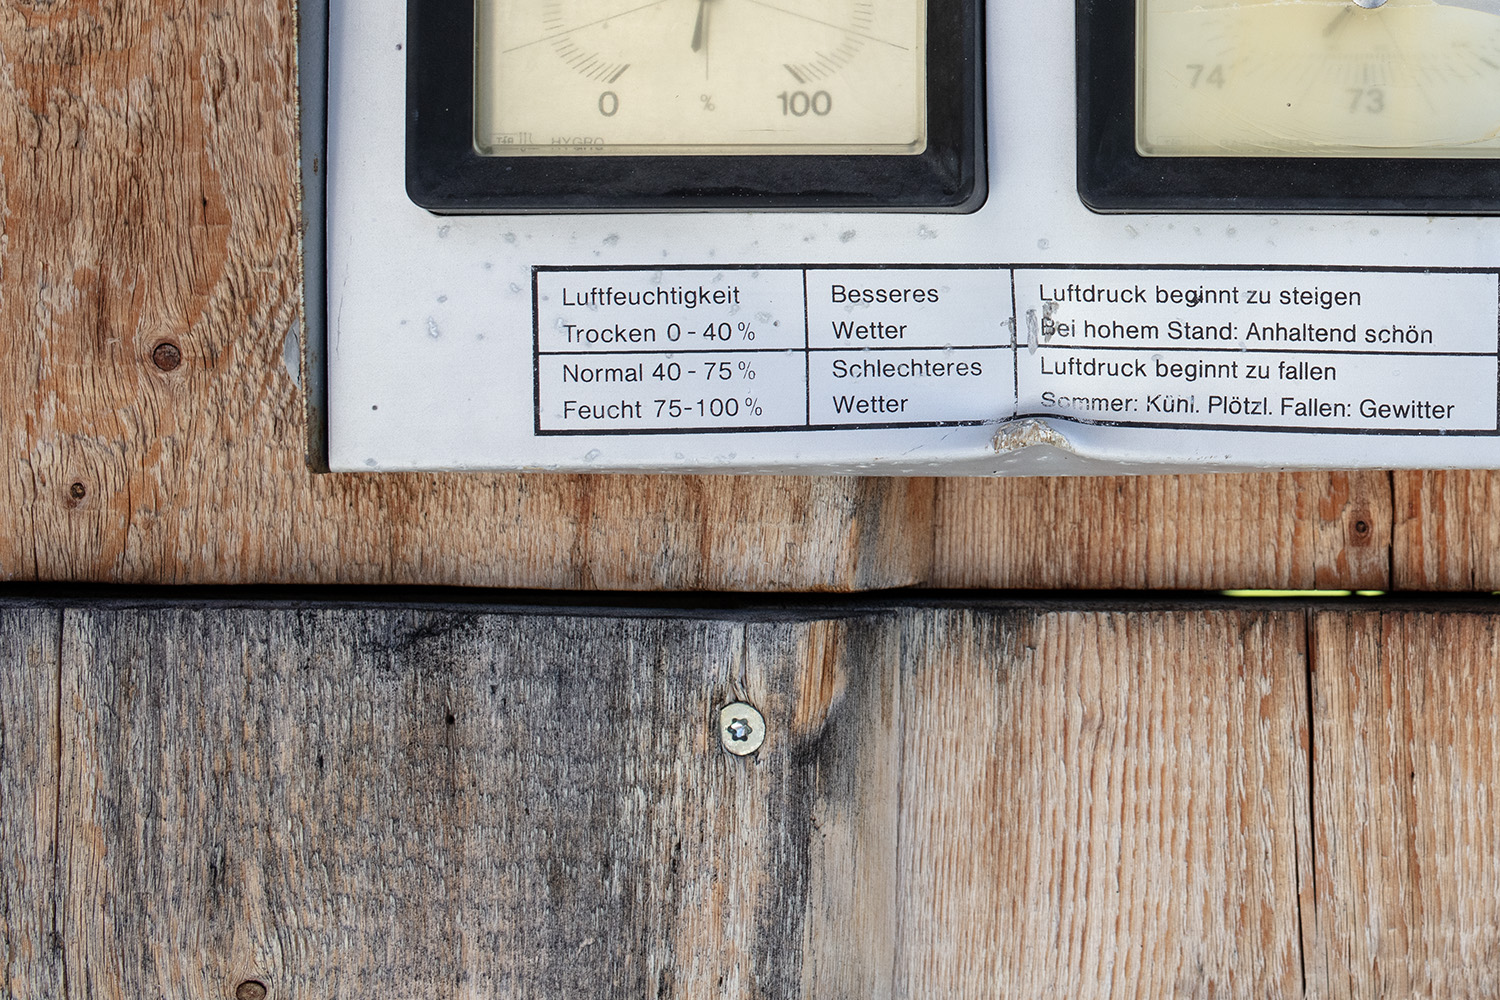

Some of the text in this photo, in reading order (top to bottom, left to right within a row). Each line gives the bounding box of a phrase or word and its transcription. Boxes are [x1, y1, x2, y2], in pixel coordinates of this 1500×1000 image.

[1185, 63, 1226, 90] 74
[598, 91, 620, 117] 0
[700, 94, 716, 111] %
[777, 90, 833, 117] 100
[1346, 87, 1385, 115] 73
[562, 285, 741, 309] Luftfeuchtigkeit
[831, 284, 940, 304] Besseres
[1039, 283, 1361, 310] Luftdruck beginnt zu steigen
[562, 323, 656, 344] Trocken
[831, 320, 908, 340] Wetter
[1041, 316, 1433, 344] Bei hohem Stand: Anhaltend schön
[563, 362, 643, 383] Normal
[832, 358, 983, 379] Schlechteres
[1040, 356, 1337, 383] Luftdruck beginnt zu fallen
[563, 399, 642, 420] Feucht
[832, 395, 909, 414] Wetter
[1040, 391, 1456, 420] Sommer: Kühl. Plötzl. Fallen: Gewitter
